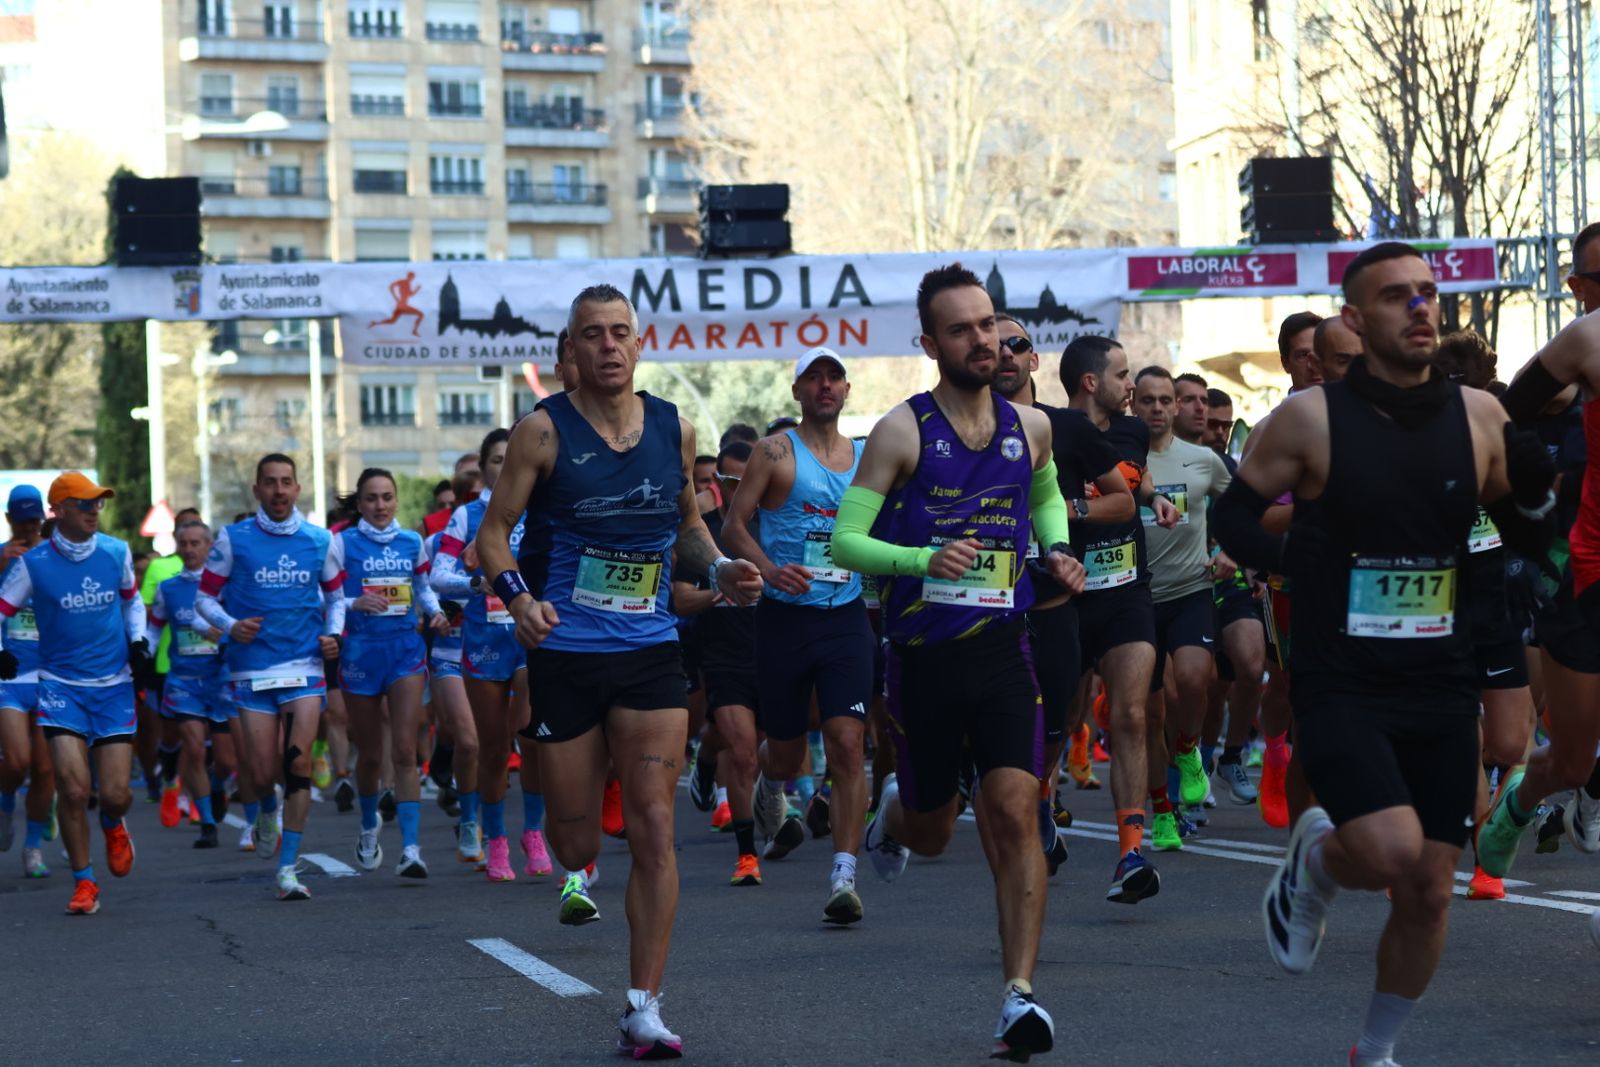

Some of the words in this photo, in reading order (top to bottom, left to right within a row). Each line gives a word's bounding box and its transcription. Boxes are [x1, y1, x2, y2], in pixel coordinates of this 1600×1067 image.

[1157, 257, 1243, 274] LABORAL
[6, 276, 109, 293] Ayuntamiento
[219, 272, 320, 293] Ayuntamiento
[630, 263, 873, 314] MEDIA
[1208, 275, 1244, 287] kutxa
[6, 298, 23, 314] de
[28, 298, 110, 315] Salamanca
[218, 295, 236, 310] de
[241, 293, 322, 310] Salamanca
[639, 313, 868, 352] MARATÓN
[363, 346, 430, 359] CIUDAD
[439, 346, 459, 359] DE
[468, 345, 557, 359] SALAMAN
[362, 555, 413, 572] debra
[970, 553, 996, 572] 04
[1093, 548, 1124, 565] 436
[254, 566, 311, 583] debra
[604, 563, 644, 583] 735
[383, 587, 398, 597] 10
[1376, 574, 1444, 597] 1717
[60, 590, 115, 609] debra
